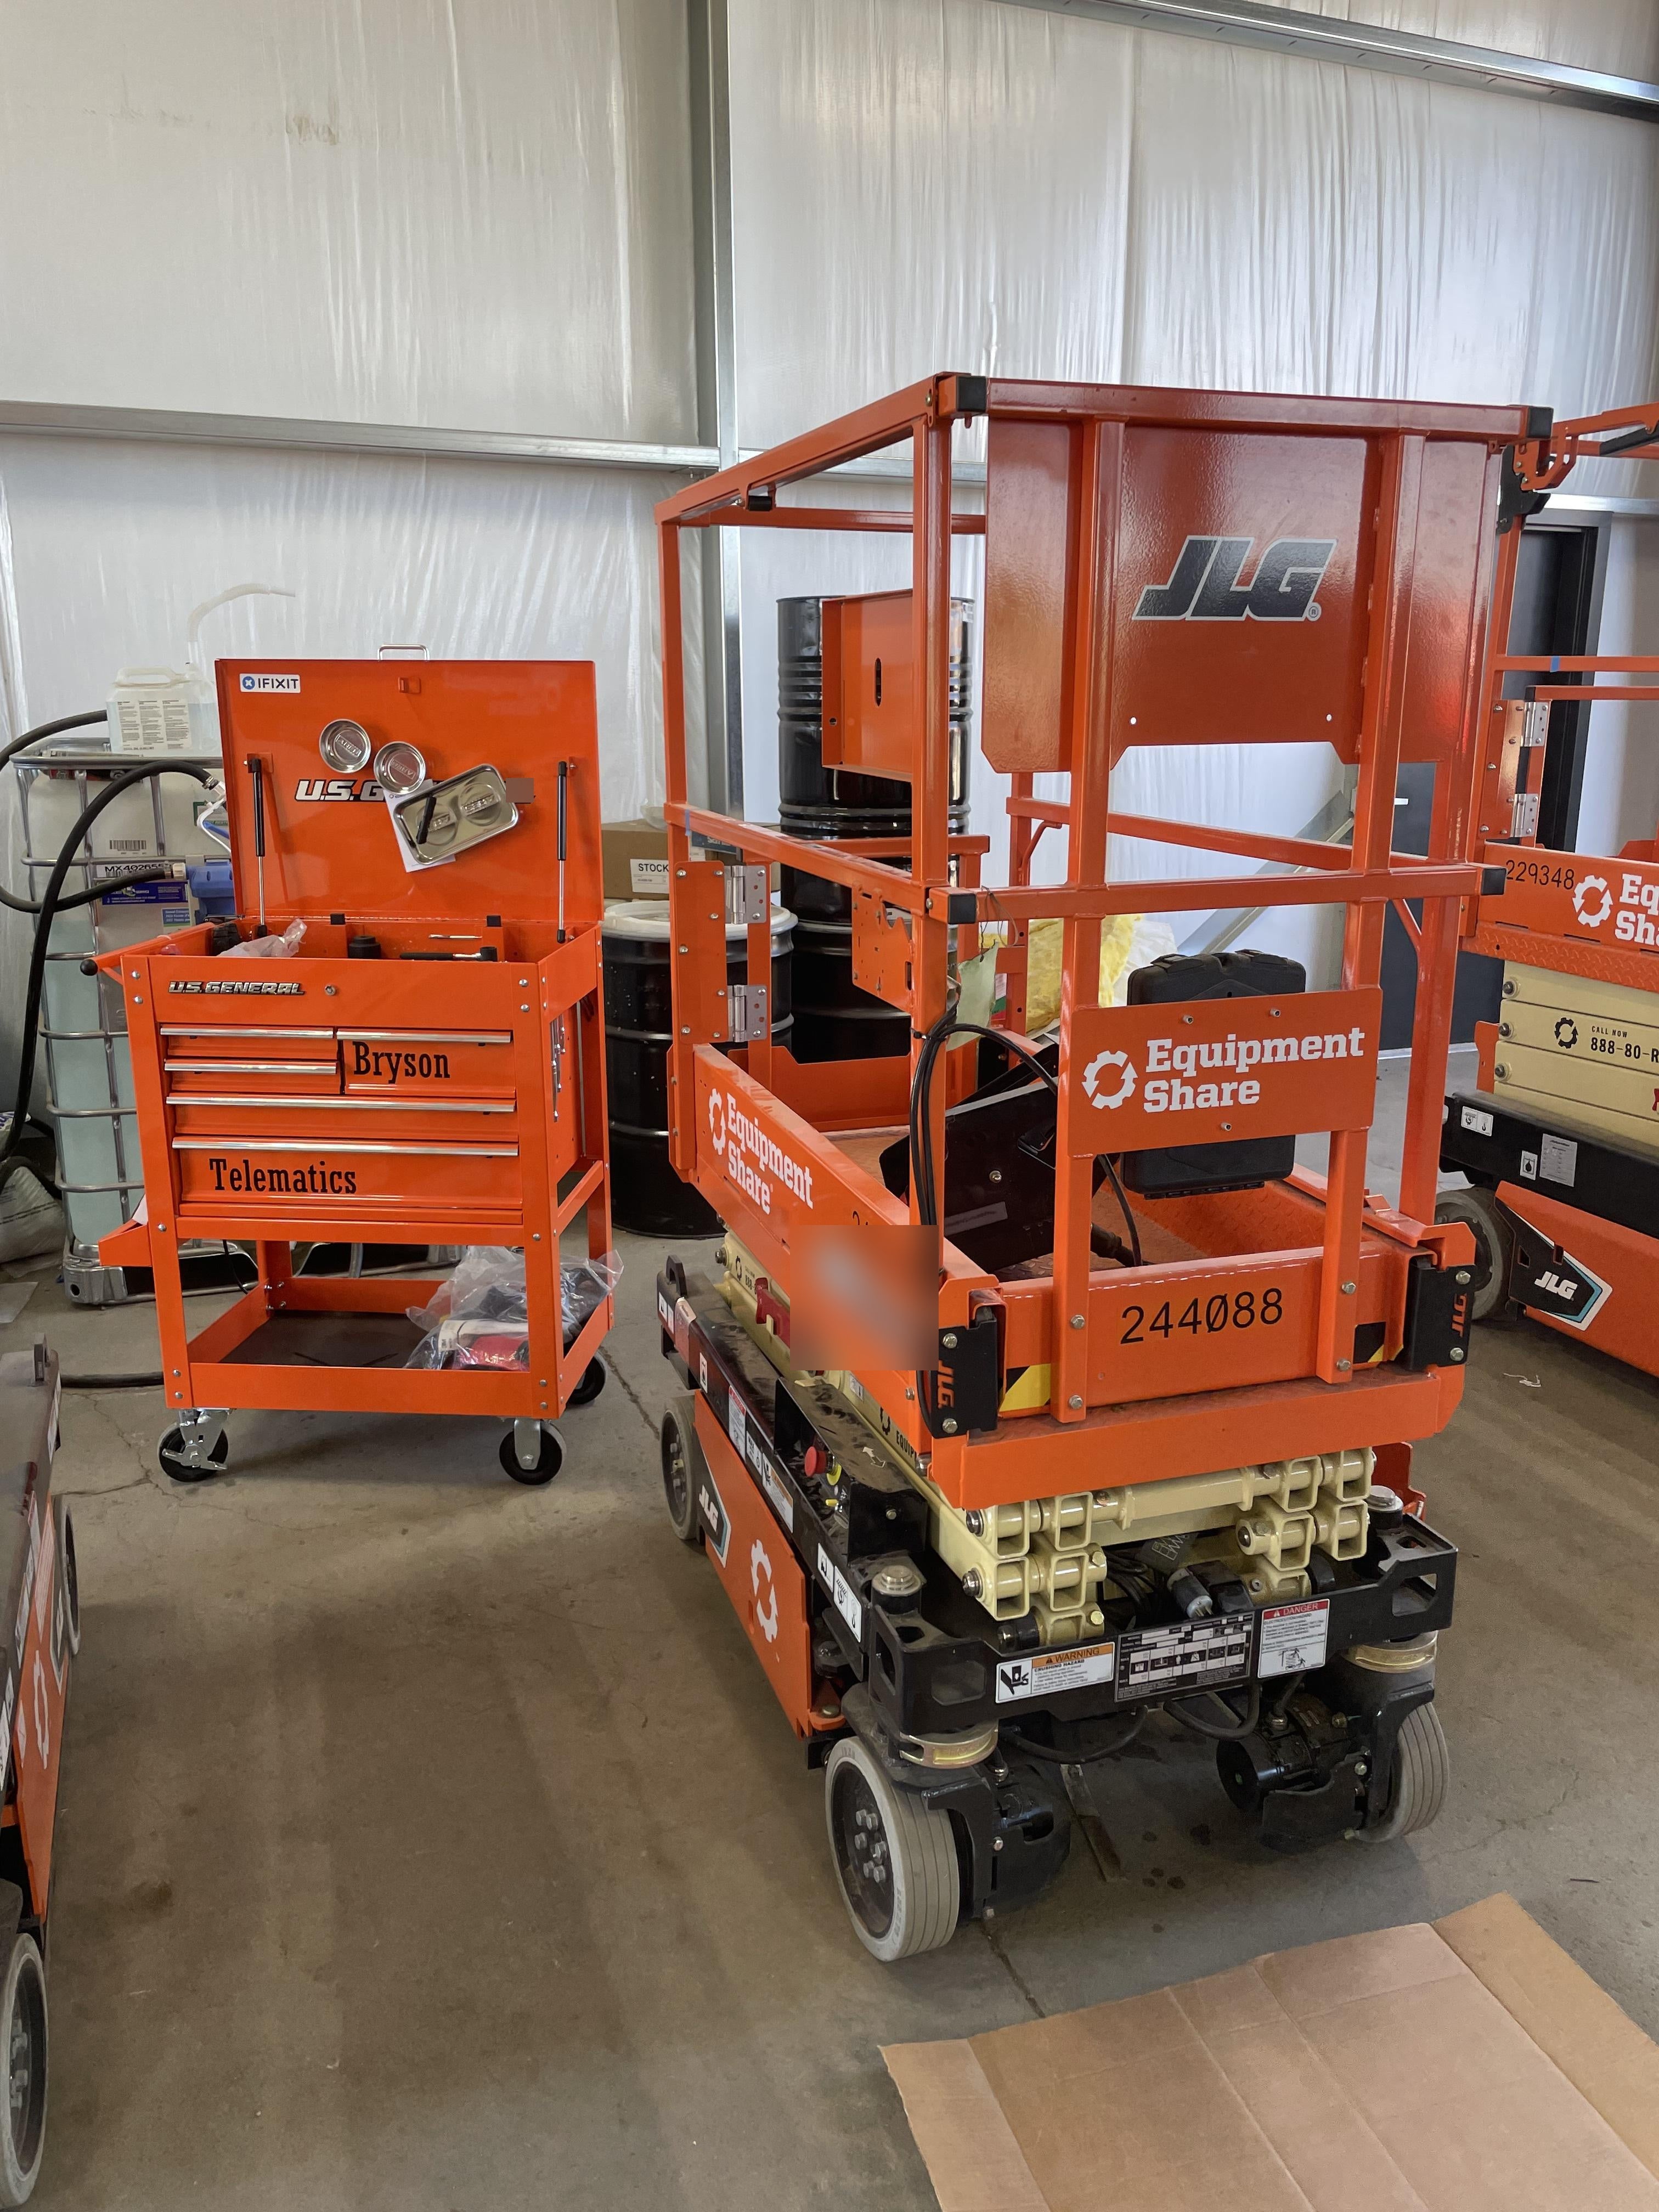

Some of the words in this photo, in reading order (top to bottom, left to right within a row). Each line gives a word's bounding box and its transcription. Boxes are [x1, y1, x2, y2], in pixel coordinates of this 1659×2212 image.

[1132, 535, 1337, 621] JLG
[257, 678, 299, 690] IFIXIT
[638, 863, 669, 873] STOCK
[1505, 859, 1575, 890] 229348
[1592, 1025, 1609, 1035] CALL
[1612, 1029, 1628, 1038] NOW
[352, 1041, 450, 1084] Bryson
[1145, 1027, 1365, 1077] Equipment
[1143, 1079, 1260, 1113] Share
[727, 1092, 814, 1210] Equipment
[209, 1158, 357, 1194] Telematics
[727, 1139, 771, 1215] Share
[1534, 1271, 1578, 1300] JLG
[1451, 1293, 1468, 1338] JLG
[896, 1430, 917, 1462] EQUIP
[698, 1484, 719, 1534] JLG
[1283, 1604, 1318, 1615] DANGER
[1056, 1647, 1099, 1662] WARNING
